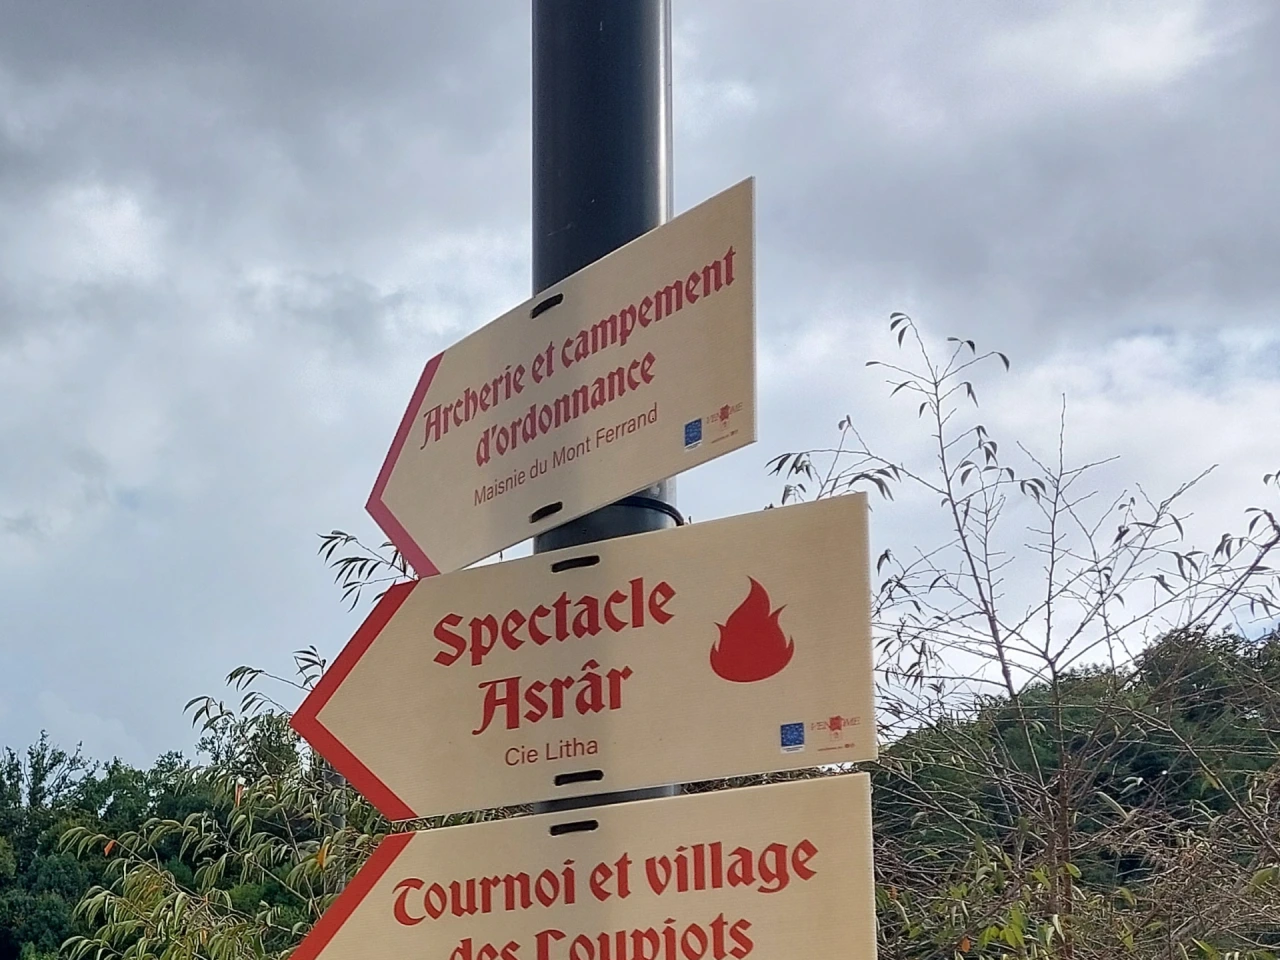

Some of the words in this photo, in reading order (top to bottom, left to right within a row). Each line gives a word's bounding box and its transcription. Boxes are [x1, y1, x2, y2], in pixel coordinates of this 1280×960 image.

[419, 364, 526, 451] Archerie
[531, 340, 556, 384] et
[562, 246, 737, 369] campement
[474, 470, 526, 507] Maisnie
[529, 458, 548, 479] du
[552, 436, 591, 469] Mont
[596, 401, 658, 449] Ferrand
[475, 351, 656, 468] d'ordonnance
[432, 576, 677, 667] Spectacle
[471, 658, 634, 736] Asrâr
[504, 747, 539, 767] Cie
[545, 737, 599, 761] Litha
[391, 858, 576, 927] Tournoi
[588, 851, 633, 902] et
[644, 838, 819, 896] village
